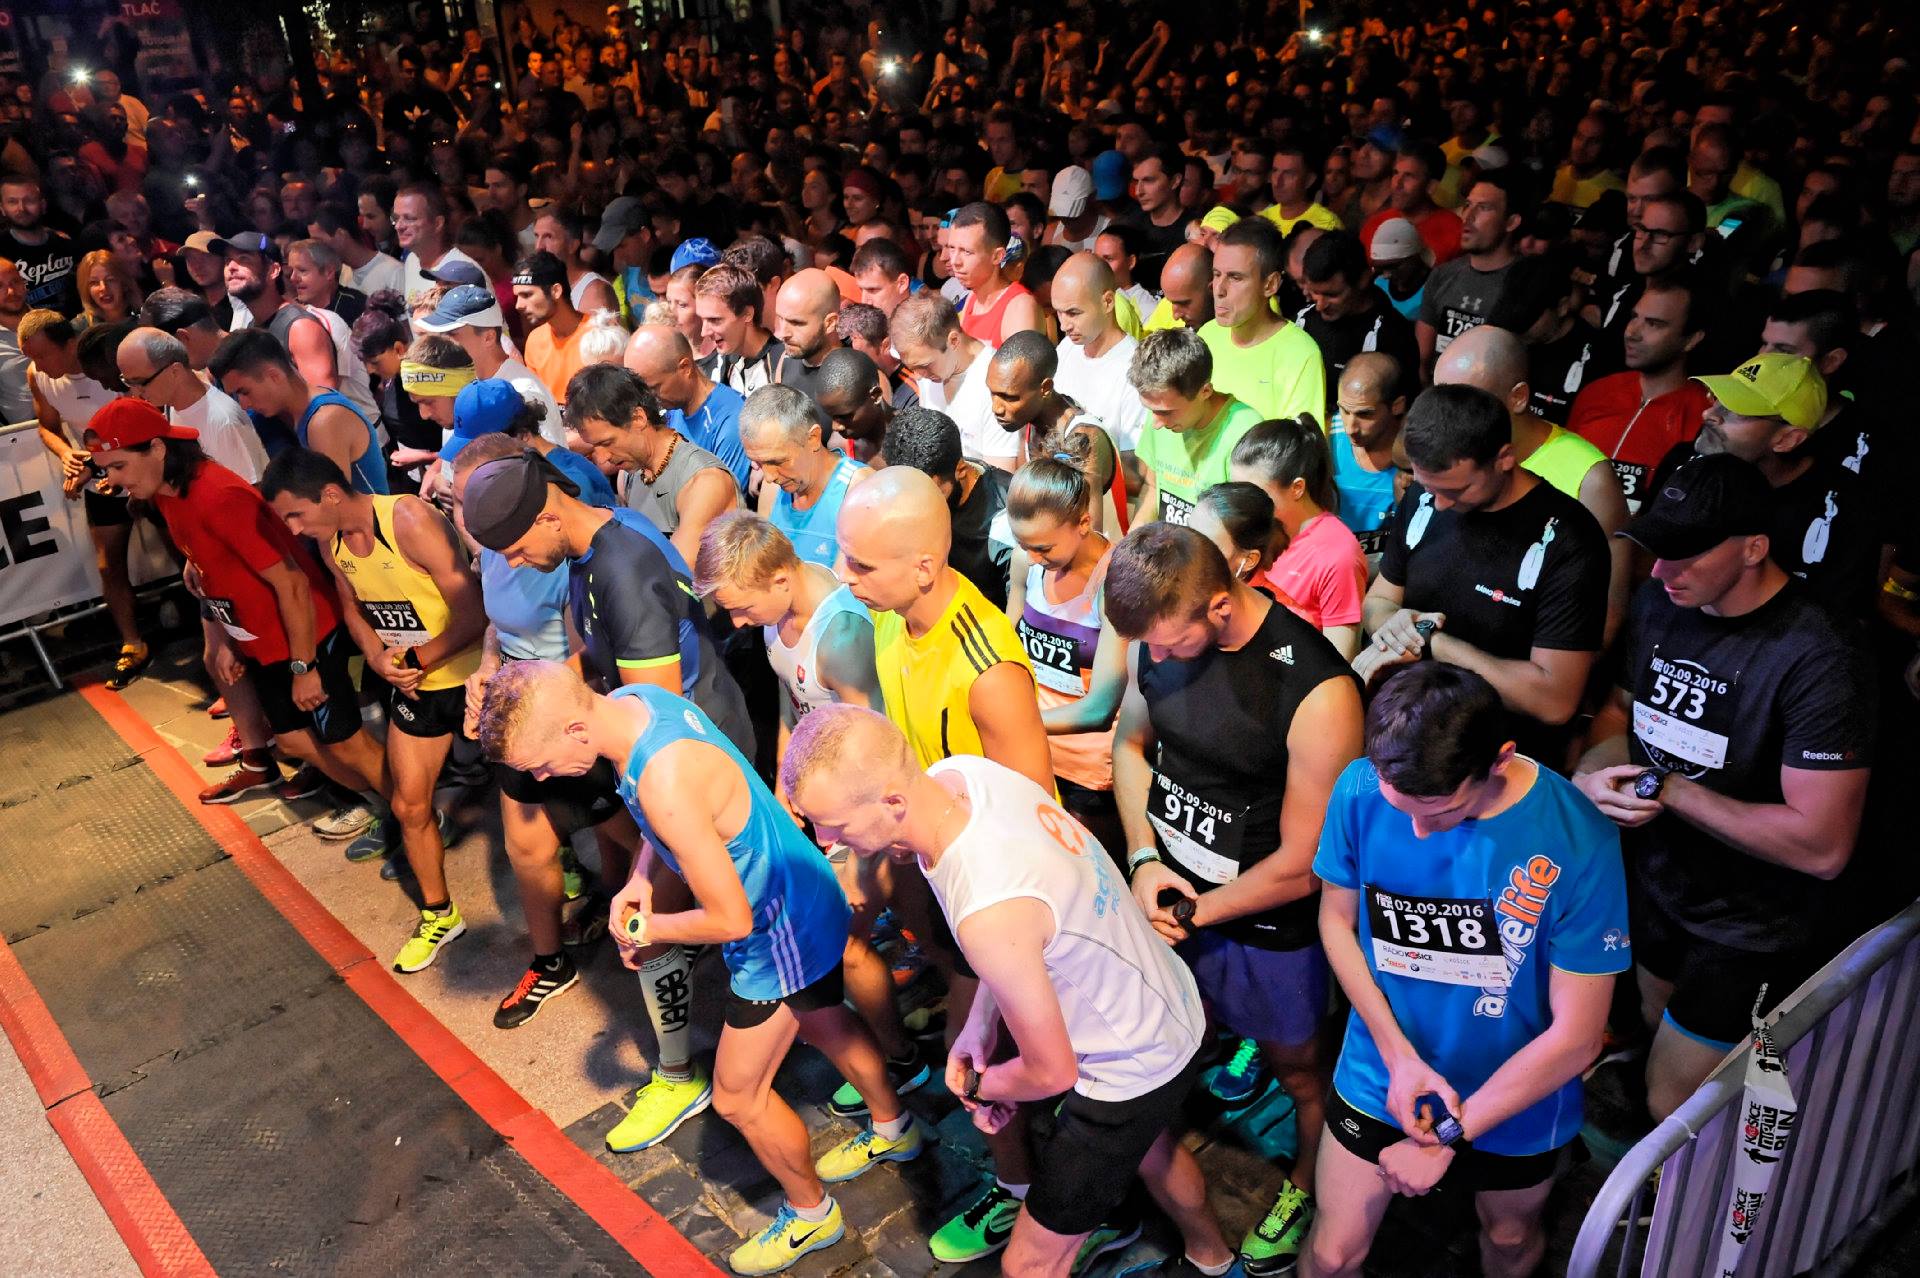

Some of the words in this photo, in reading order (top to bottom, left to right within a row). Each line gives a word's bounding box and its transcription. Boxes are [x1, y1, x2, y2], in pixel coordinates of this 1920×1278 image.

[16, 252, 74, 286] Replay
[373, 610, 419, 629] 1375
[1020, 632, 1074, 672] 1072
[1025, 627, 1074, 651] 02.09.2016
[1662, 663, 1728, 696] 02.09.2016
[1649, 674, 1708, 720] 573
[1802, 750, 1844, 761] Reebok
[1164, 793, 1216, 845] 914
[1171, 783, 1233, 824] 02.09.2016
[1394, 898, 1485, 918] 02.09.2016
[1382, 909, 1488, 950] 1318
